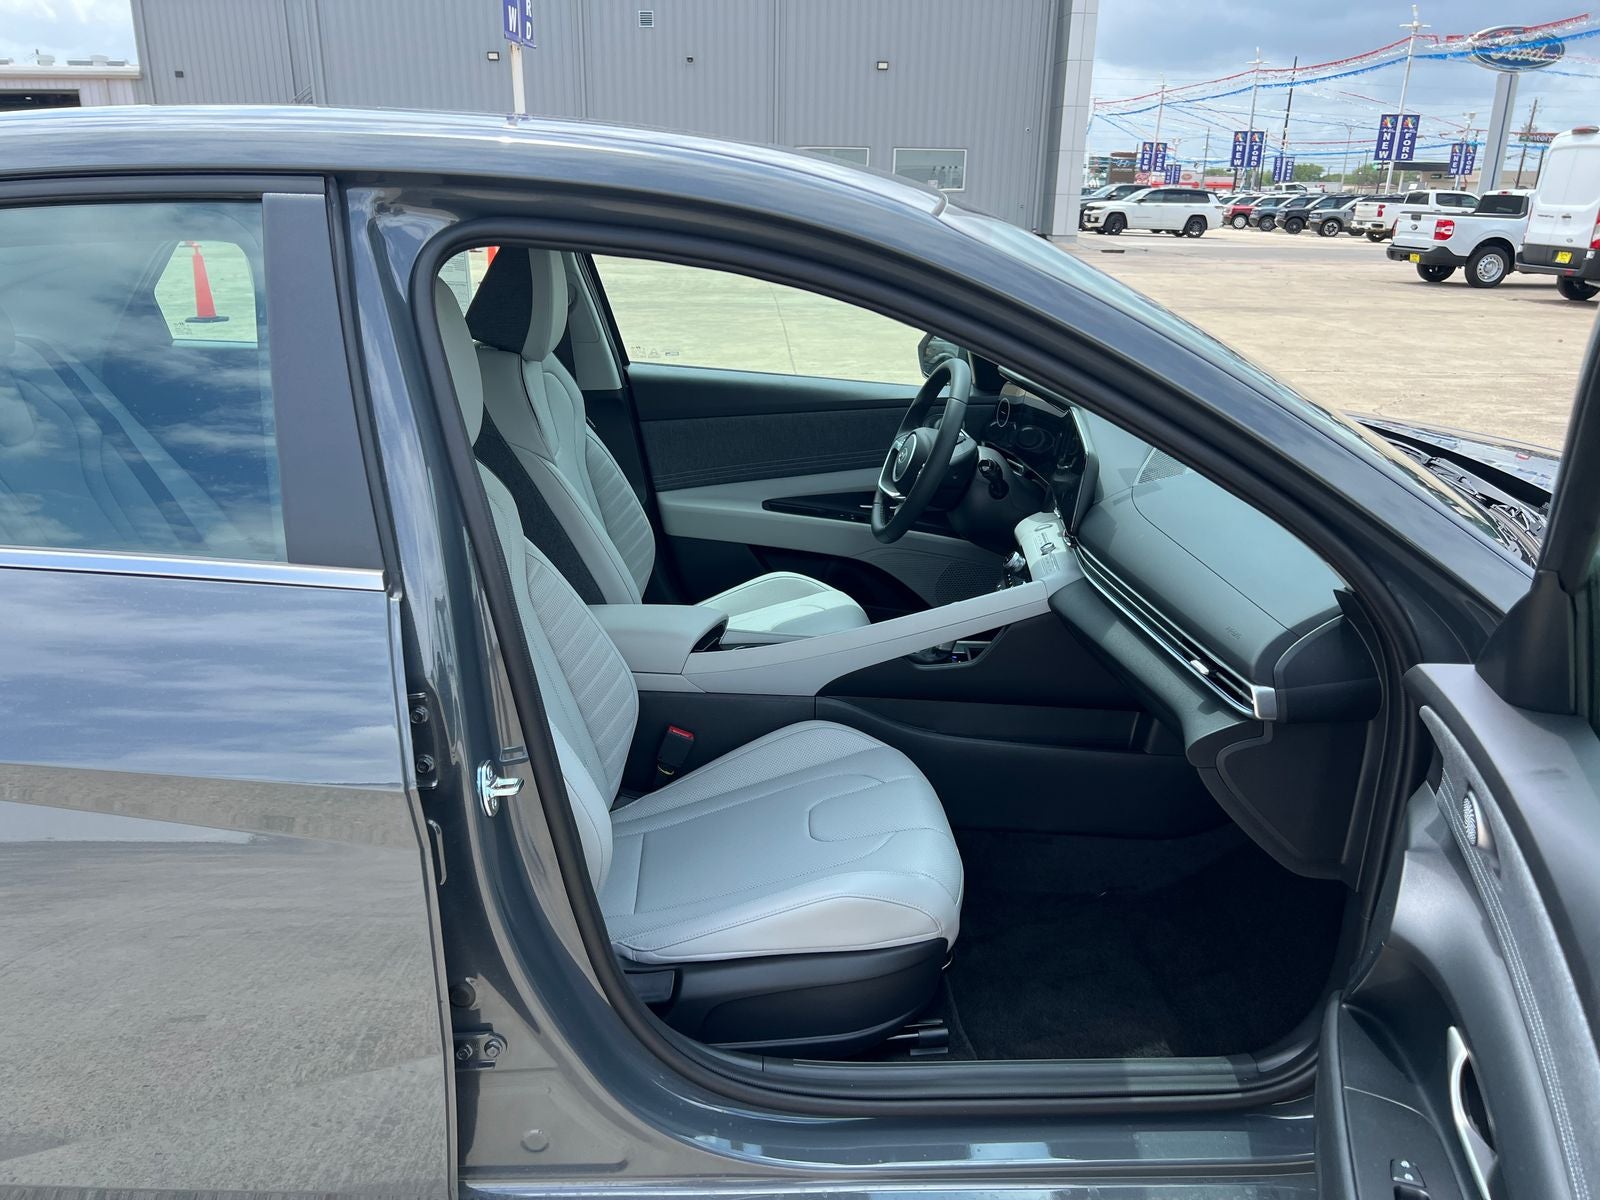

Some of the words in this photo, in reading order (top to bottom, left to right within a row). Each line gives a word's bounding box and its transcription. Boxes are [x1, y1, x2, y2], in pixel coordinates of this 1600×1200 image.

[1233, 145, 1243, 166] NEW
[1250, 145, 1259, 166] FORD
[1378, 132, 1391, 159] NEW
[1400, 132, 1412, 159] FORD
[1142, 153, 1150, 170] NEW
[1450, 155, 1459, 174] NEW
